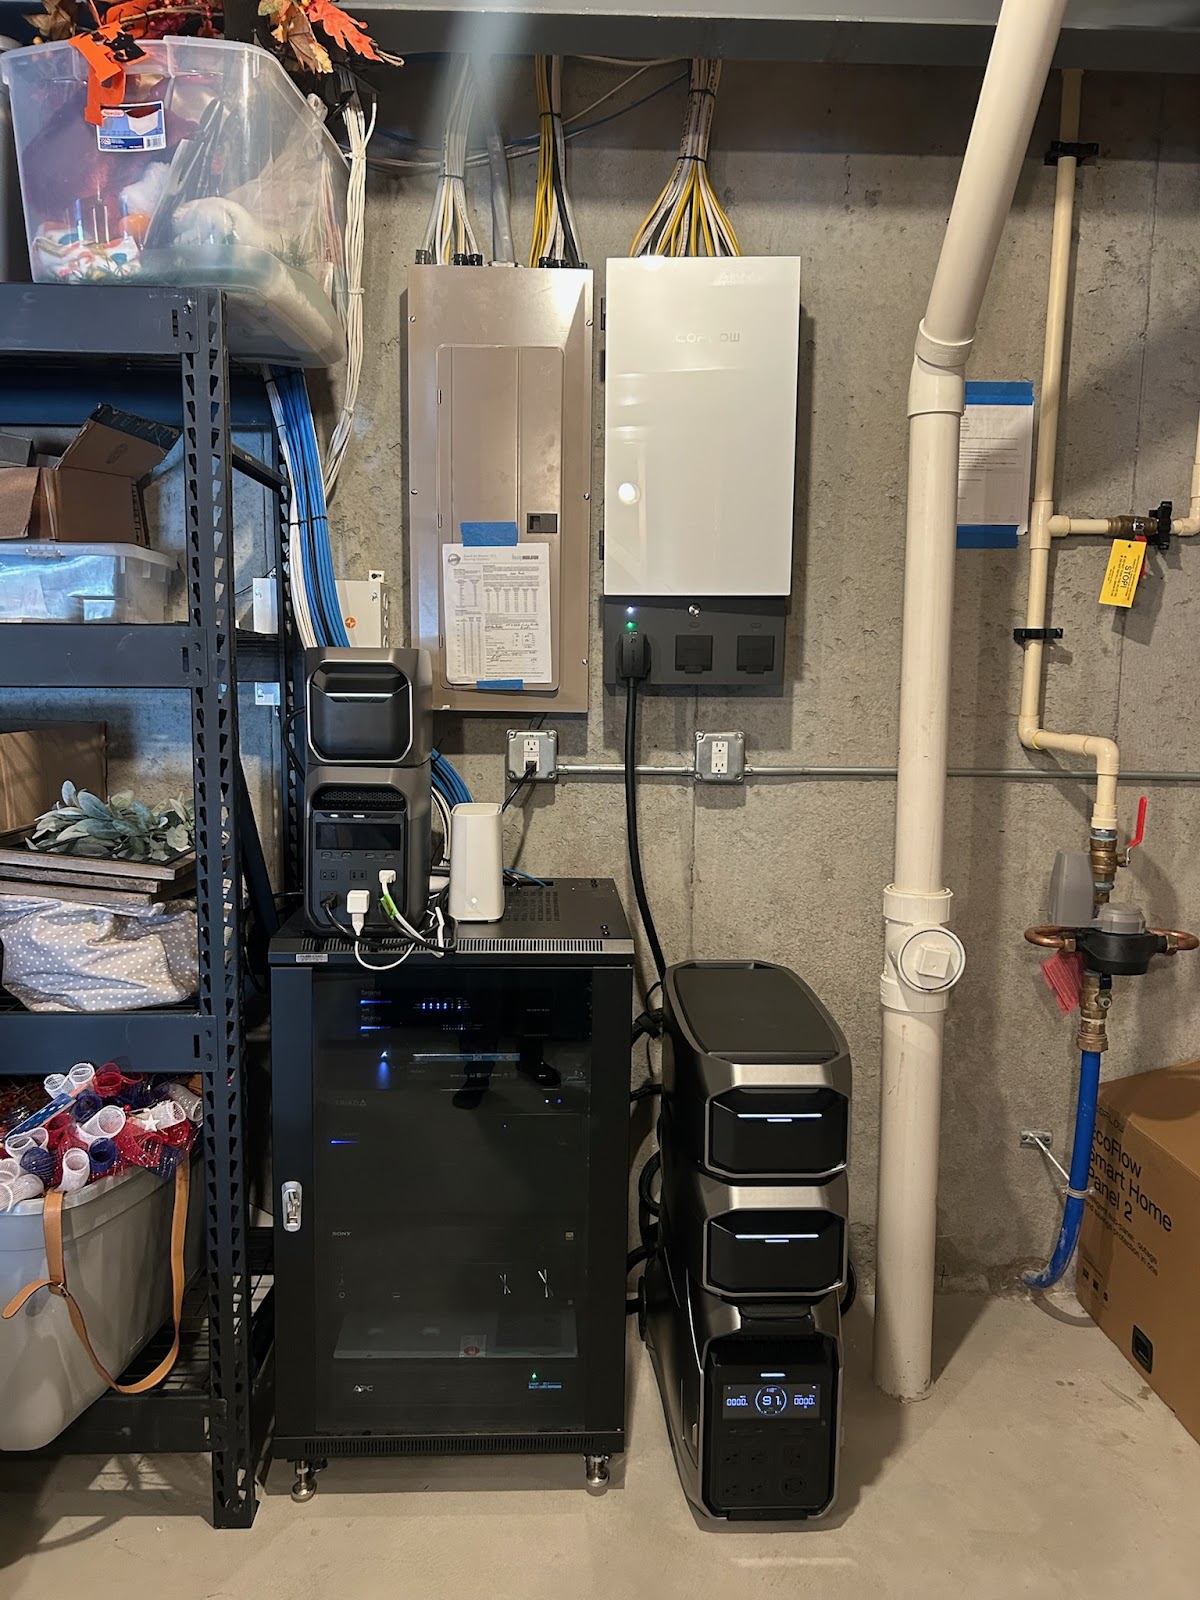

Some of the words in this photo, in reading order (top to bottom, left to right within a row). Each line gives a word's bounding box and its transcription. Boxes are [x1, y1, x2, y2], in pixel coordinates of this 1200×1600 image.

[675, 332, 740, 343] COFOW
[1120, 565, 1132, 588] STOP!
[1096, 1104, 1124, 1133] OFLOW
[1093, 1122, 1142, 1178] coFlow
[1124, 1201, 1133, 1223] 2
[1129, 1179, 1173, 1232] Home
[353, 1384, 374, 1392] APC
